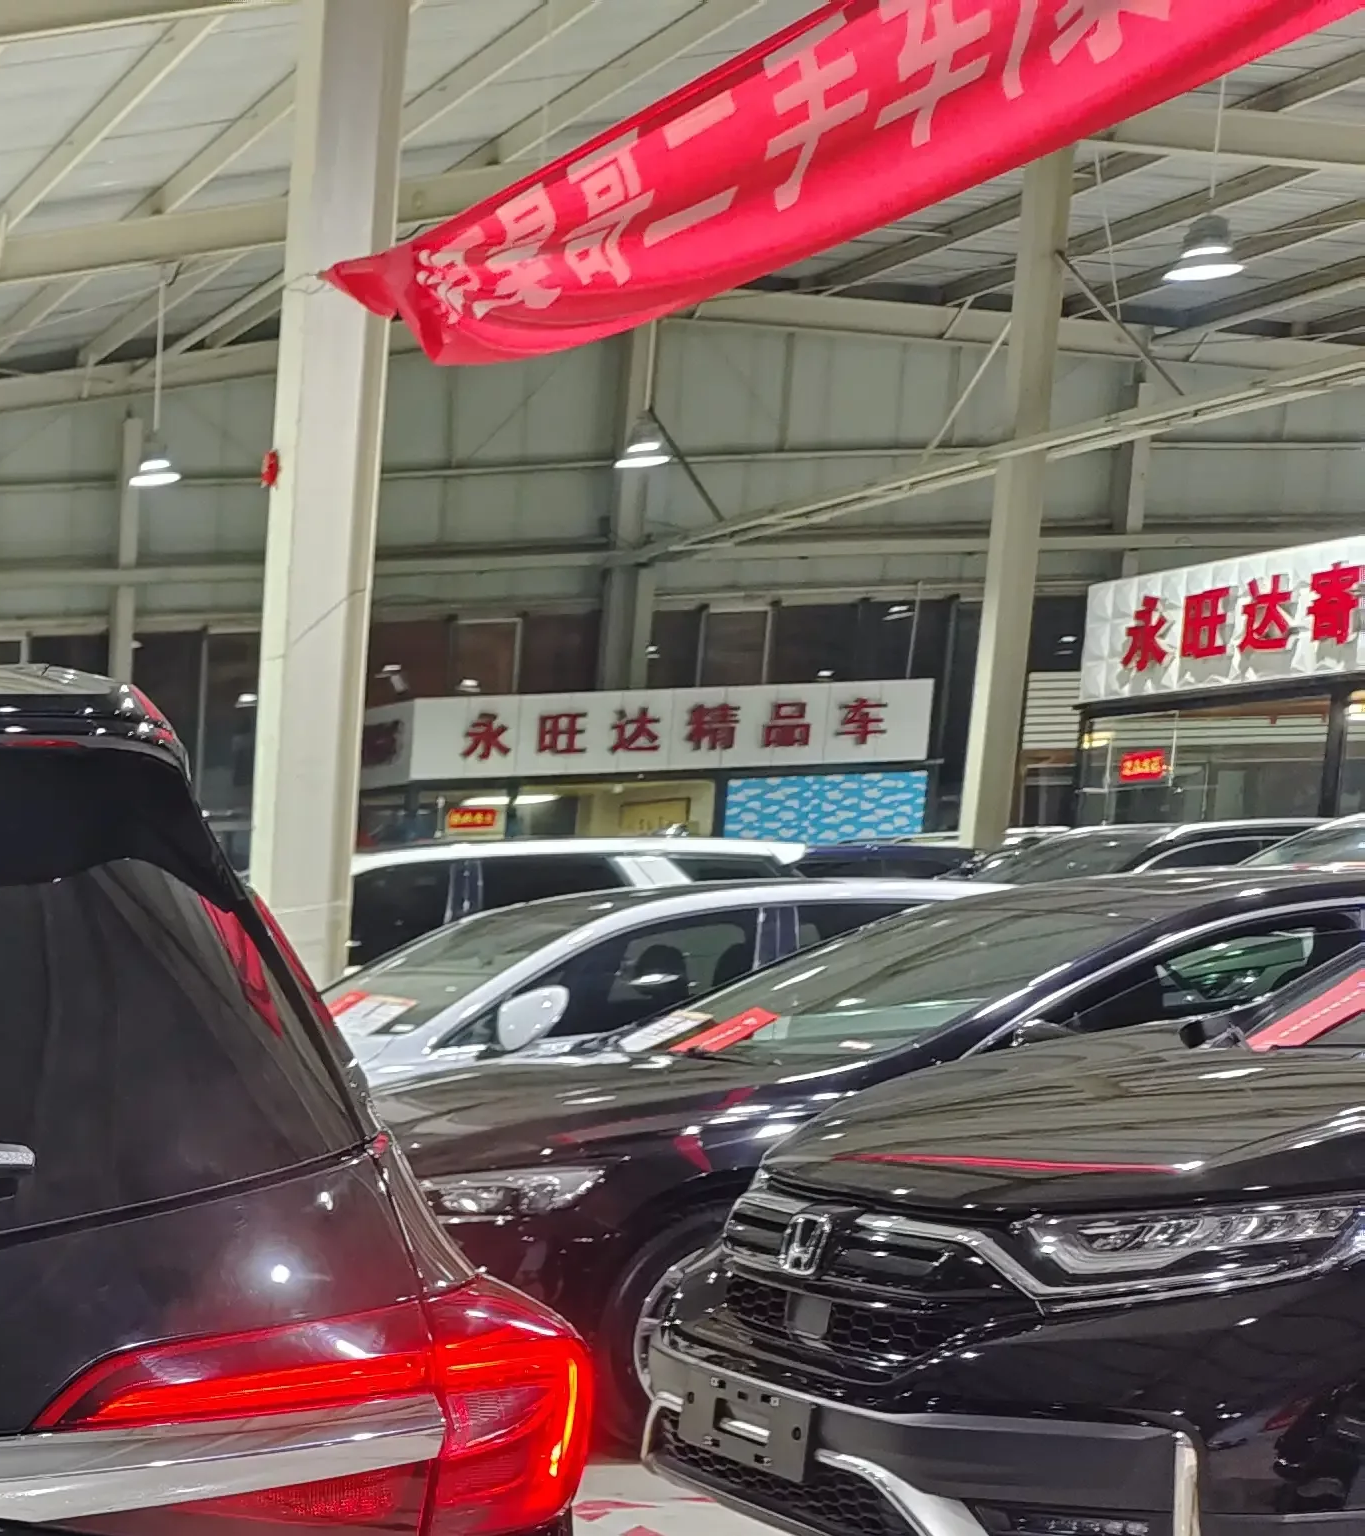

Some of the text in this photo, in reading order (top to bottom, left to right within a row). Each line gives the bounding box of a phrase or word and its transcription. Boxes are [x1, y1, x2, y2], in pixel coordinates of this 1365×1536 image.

[460, 697, 889, 760] 永旺达精品车
